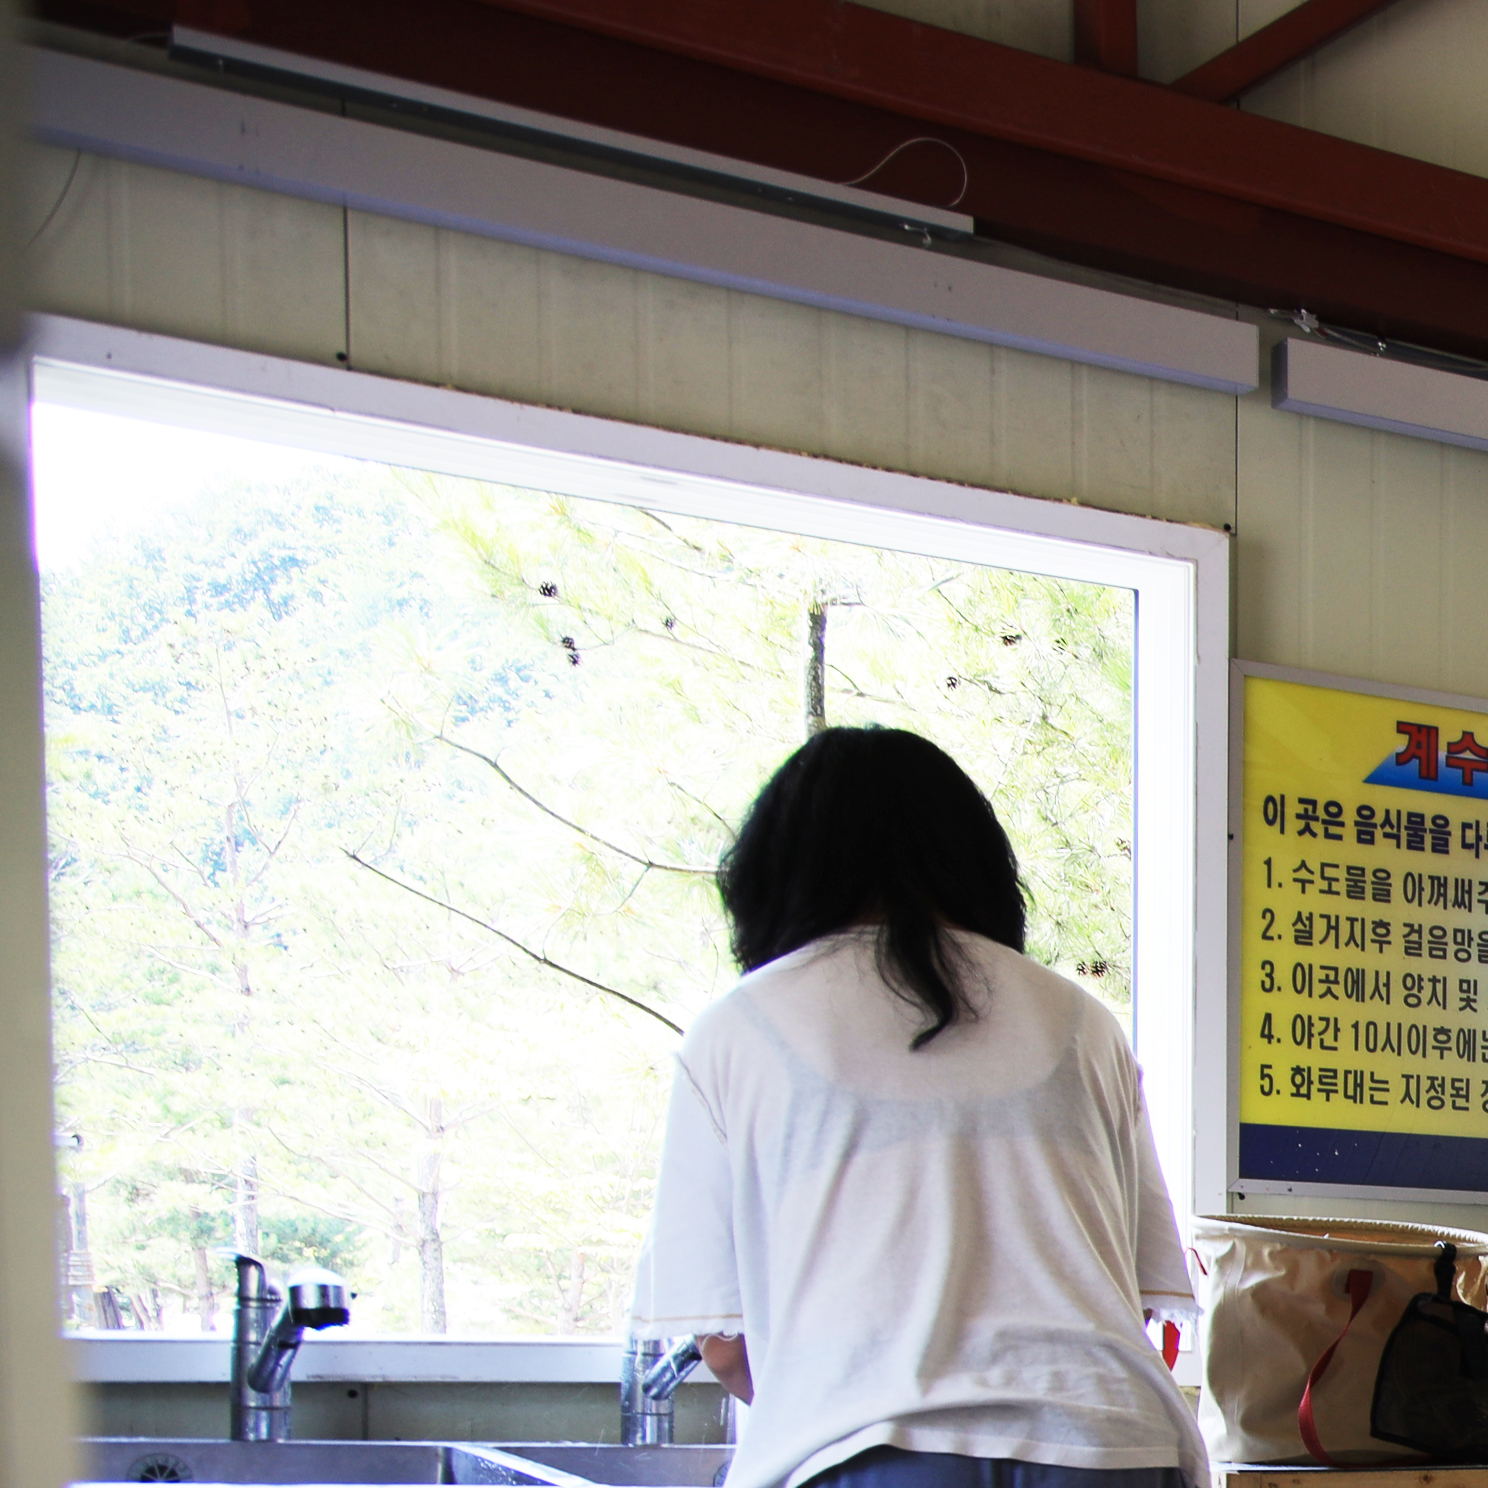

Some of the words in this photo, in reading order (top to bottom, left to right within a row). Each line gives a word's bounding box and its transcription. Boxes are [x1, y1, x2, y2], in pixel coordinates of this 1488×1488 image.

[1263, 794, 1285, 835] 이
[1295, 797, 1345, 841] 곳은
[1353, 804, 1452, 855] 음식물을
[1263, 856, 1283, 889] 1.
[1292, 858, 1392, 904] 수도물을
[1261, 907, 1282, 942] 2.
[1291, 910, 1392, 954] 설거지후
[1260, 959, 1282, 993] 3.
[1291, 961, 1391, 1006] 이곳에서
[1402, 972, 1447, 1011] 양치
[1458, 978, 1479, 1014] 및
[1259, 1012, 1282, 1045] 4.
[1291, 1013, 1341, 1052] 야간
[1259, 1064, 1281, 1097] 5.
[1290, 1065, 1390, 1106] 화루대는
[1400, 1073, 1471, 1112] 지정된
